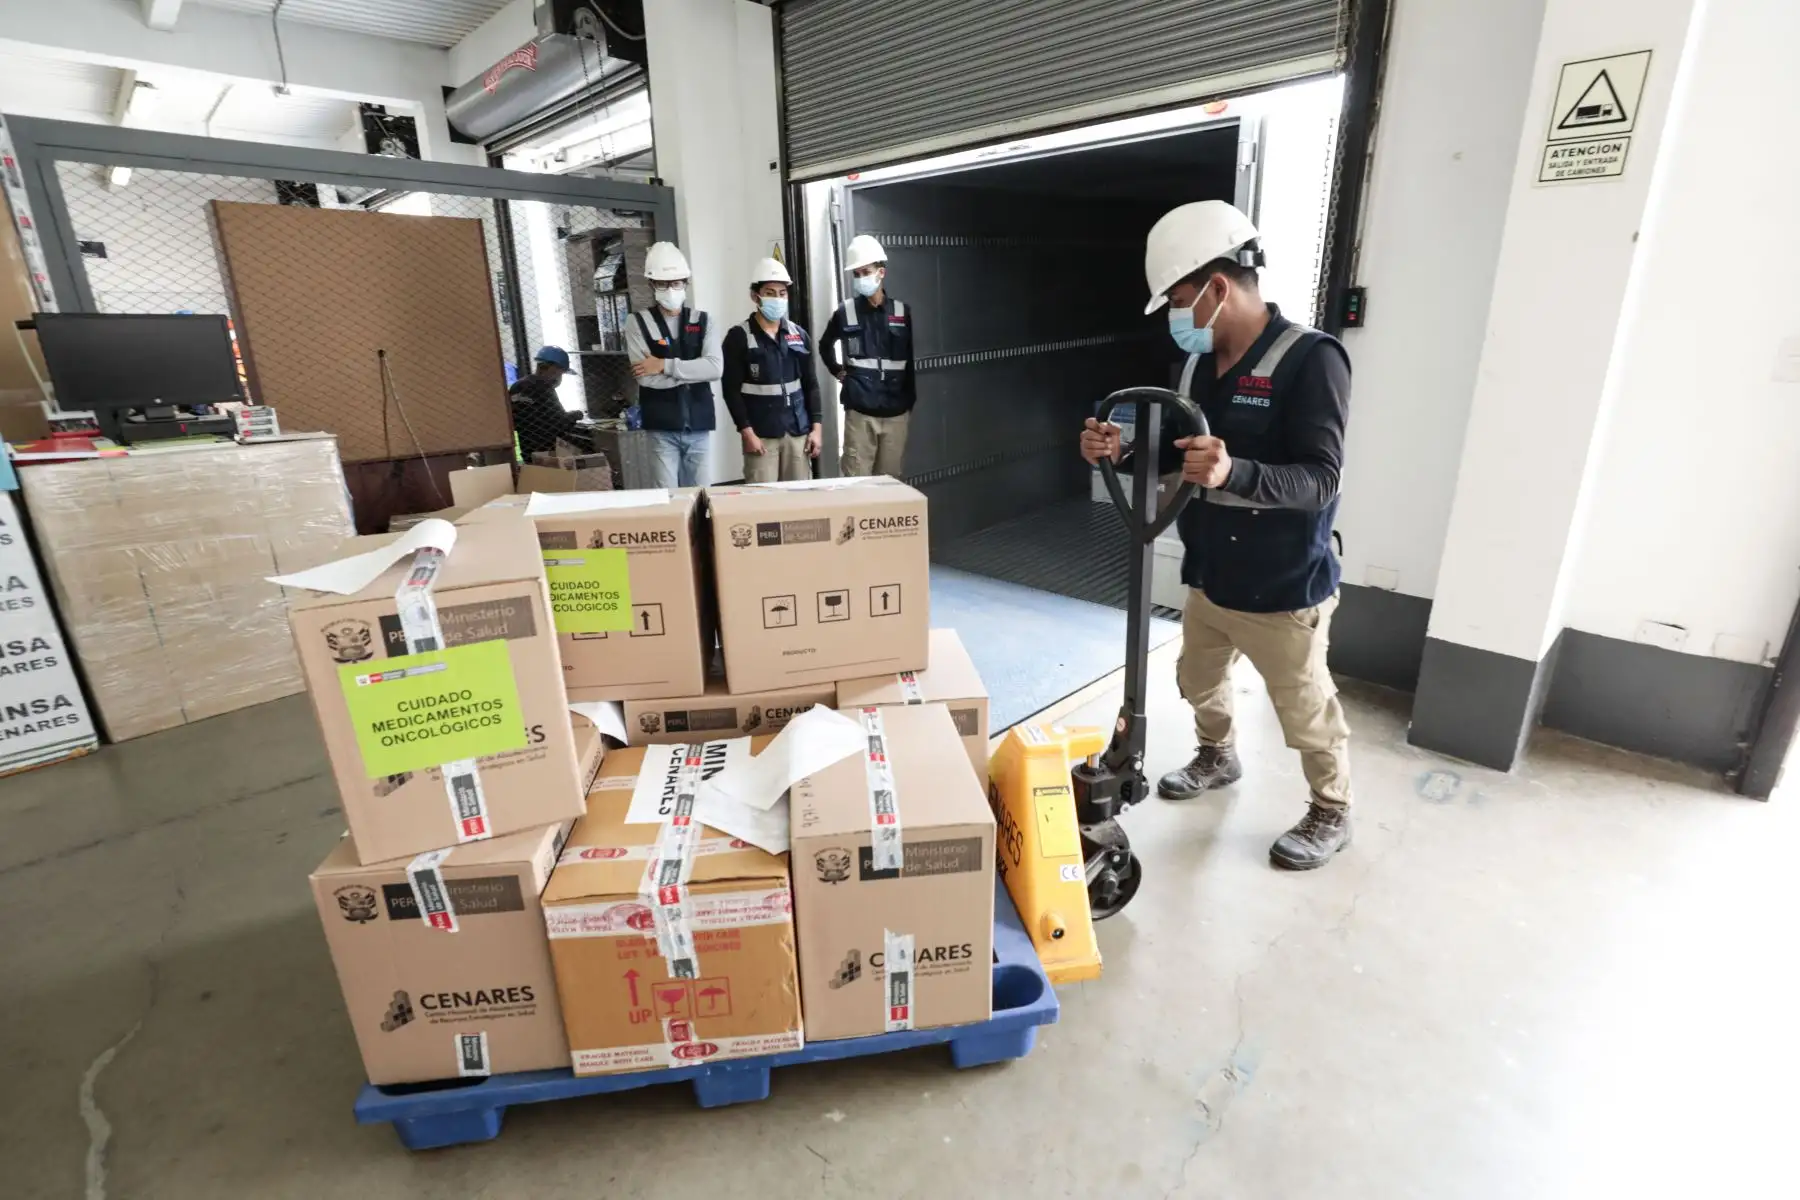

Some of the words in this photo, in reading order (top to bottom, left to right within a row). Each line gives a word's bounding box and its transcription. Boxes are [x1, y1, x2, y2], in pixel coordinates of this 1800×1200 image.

[1548, 160, 1573, 169] SALIDA
[1583, 156, 1618, 166] ENTRADA
[1555, 169, 1565, 177] DE
[1567, 166, 1606, 176] CAMIONES
[1232, 394, 1271, 407] CENARES
[859, 515, 919, 531] CENARES
[608, 530, 677, 545] CENARES
[550, 580, 600, 591] CUIDADO
[550, 591, 620, 601] DICAMENTOS
[440, 605, 516, 624] Ministerio
[467, 619, 509, 641] Salud
[397, 689, 472, 713] CUIDADO
[371, 698, 503, 734] MEDICAMENTOS
[380, 713, 502, 747] ONCOLÓGICOS
[904, 843, 969, 858] Ministerio
[924, 857, 960, 871] Salud
[460, 896, 499, 911] Salud
[869, 943, 972, 968] CARES
[420, 985, 535, 1010] CENARES
[629, 1009, 652, 1025] UP
